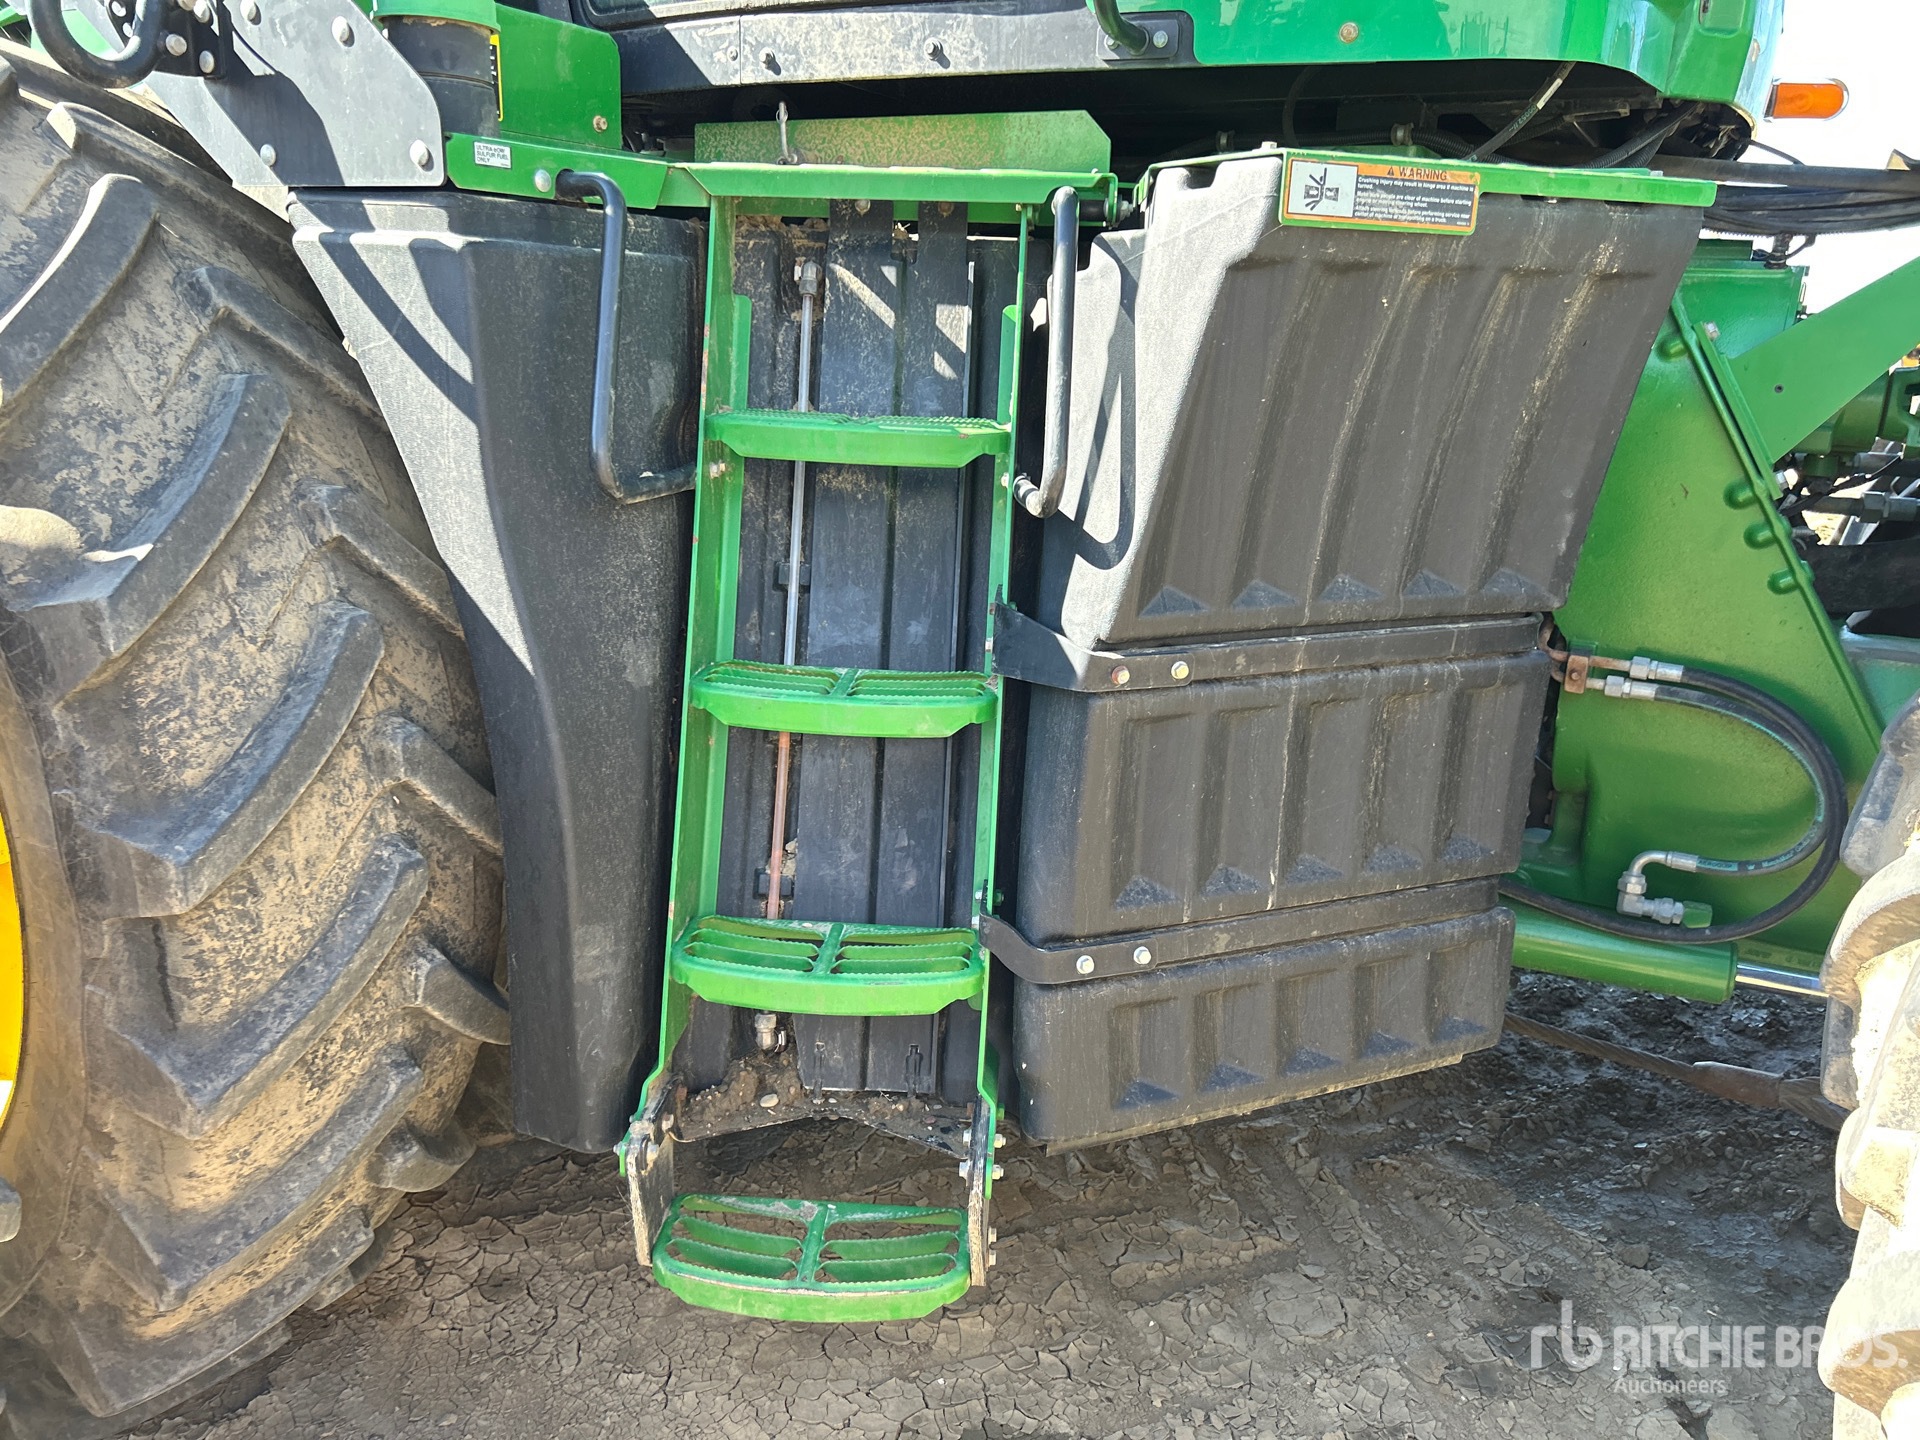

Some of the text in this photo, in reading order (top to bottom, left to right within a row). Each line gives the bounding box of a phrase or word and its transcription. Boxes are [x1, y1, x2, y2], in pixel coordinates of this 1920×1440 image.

[1399, 166, 1447, 181] WARNING
[1358, 177, 1379, 185] Crushing
[1423, 182, 1435, 190] hinge
[1455, 199, 1472, 207] starting
[1421, 210, 1444, 218] performing
